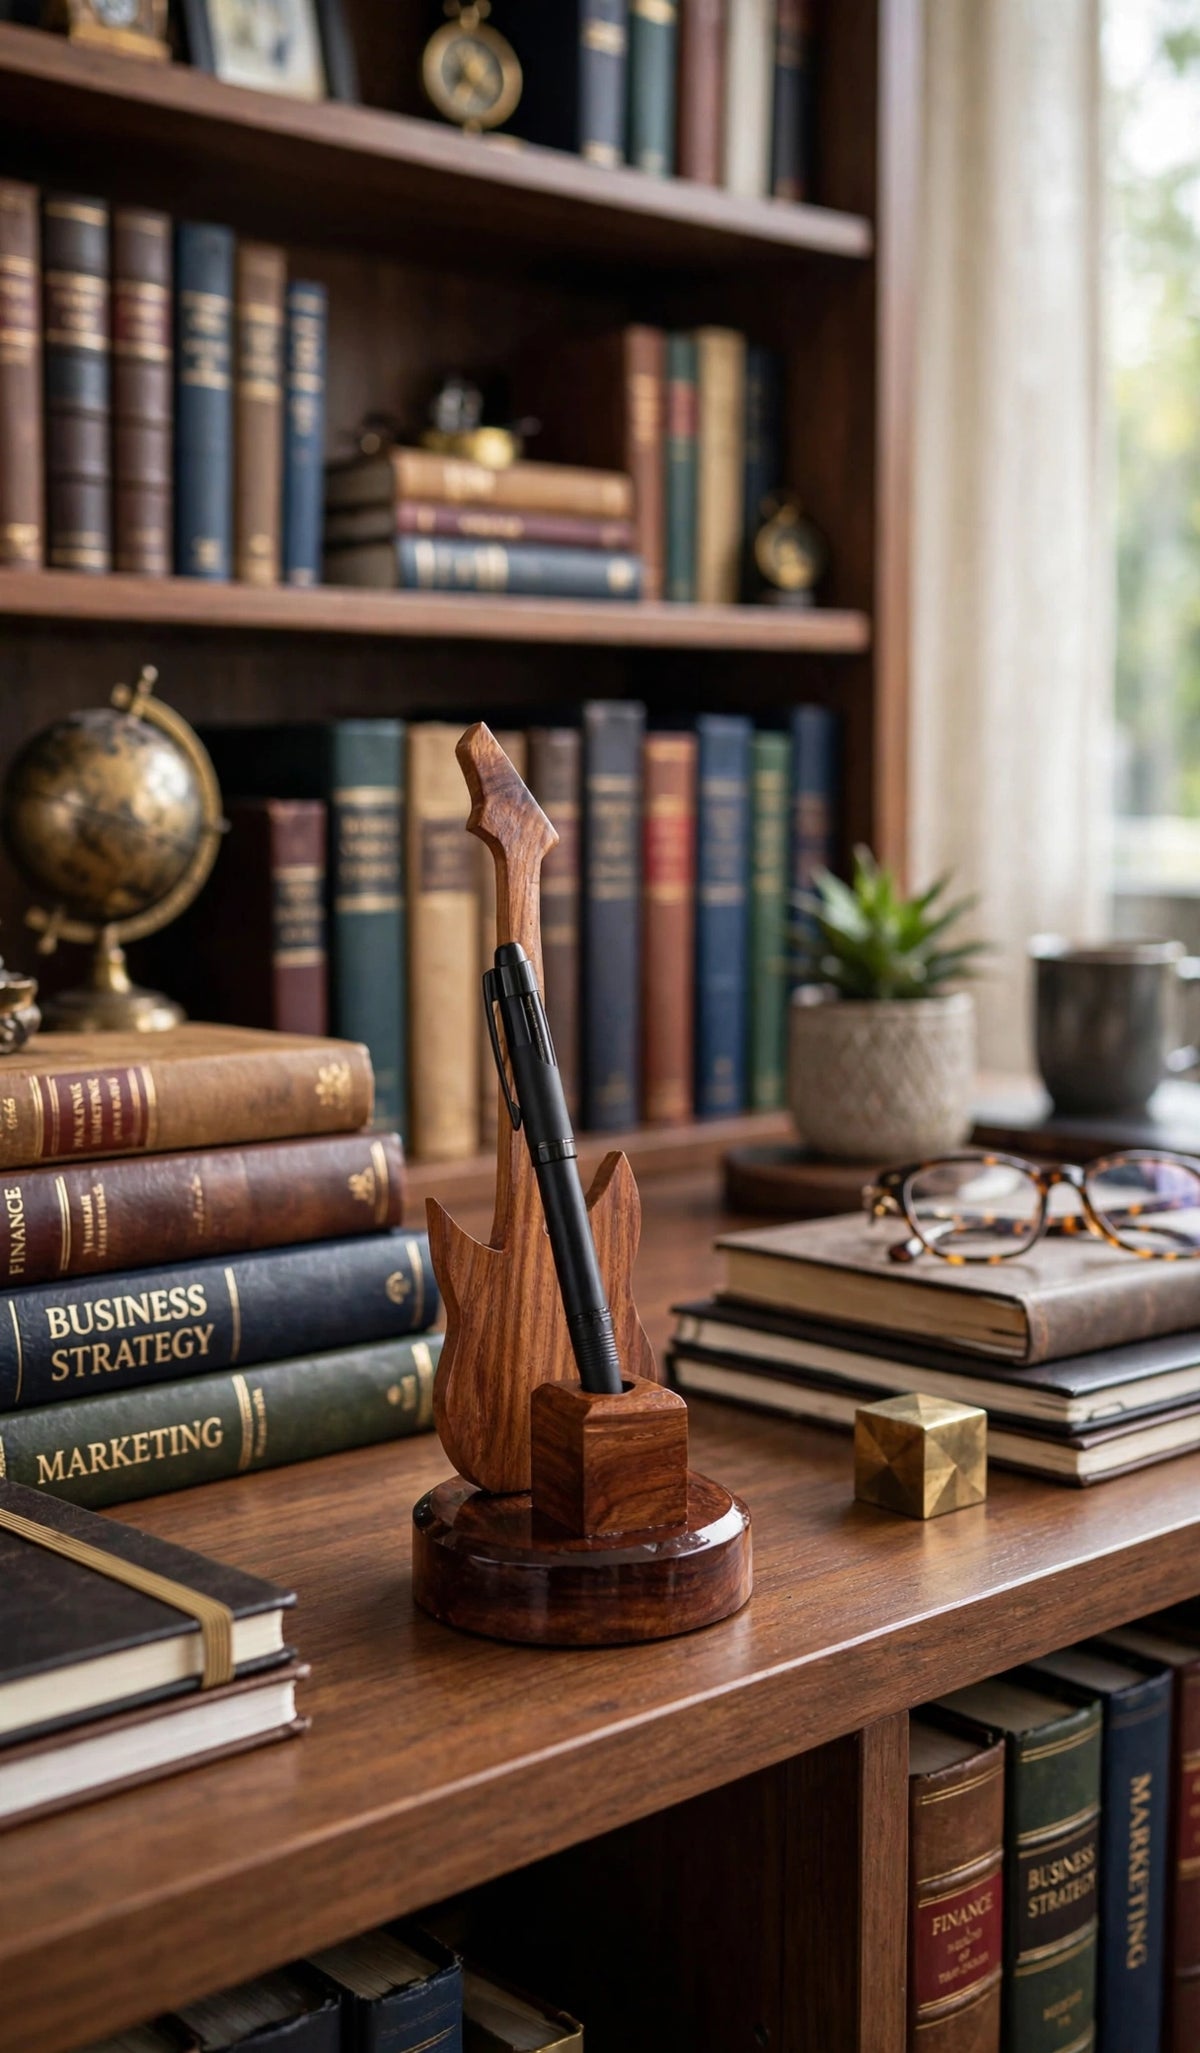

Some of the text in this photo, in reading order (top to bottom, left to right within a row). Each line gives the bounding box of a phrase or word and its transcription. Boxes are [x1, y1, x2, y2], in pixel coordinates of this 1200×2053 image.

[4, 1183, 26, 1275] FINANCE
[45, 1284, 208, 1339] BUSINESS
[51, 1323, 215, 1381] STRATEGY
[36, 1416, 223, 1485] MARKETING
[1028, 1844, 1095, 1891] BUSINESS
[1028, 1870, 1096, 1918] STRATEGY
[1126, 1772, 1152, 1969] MARKETING
[932, 1891, 994, 1936] FINANCE
